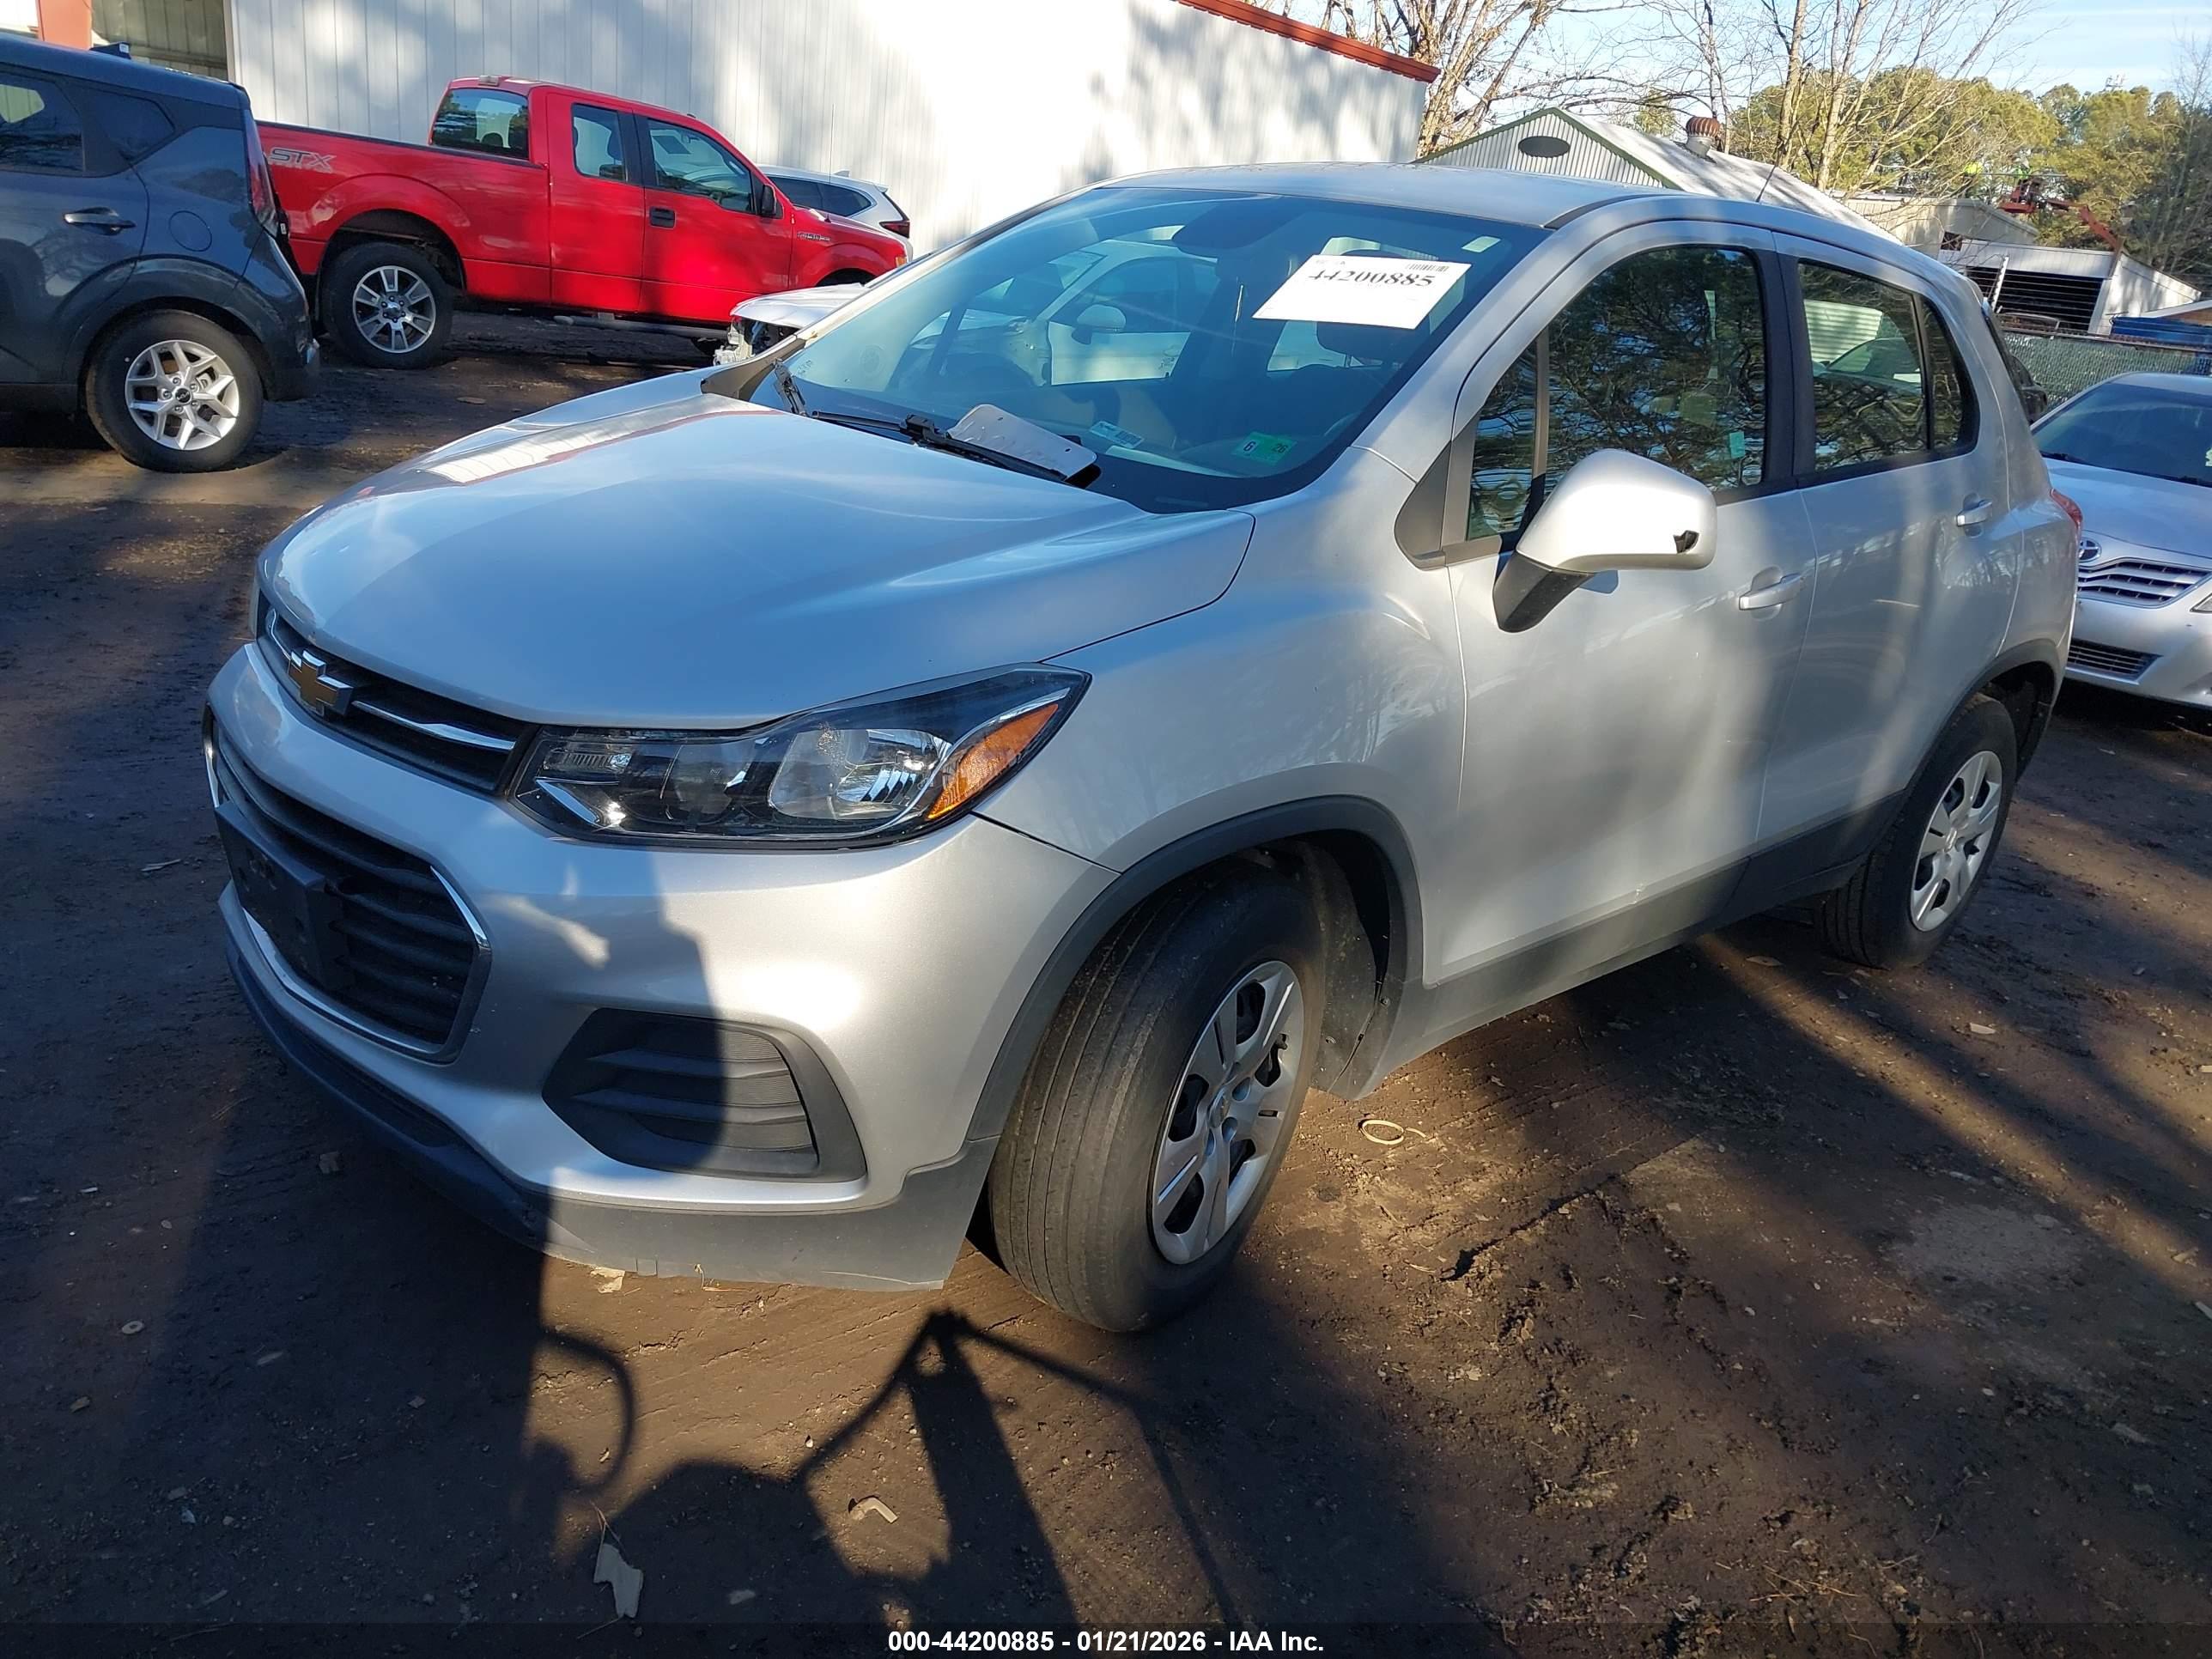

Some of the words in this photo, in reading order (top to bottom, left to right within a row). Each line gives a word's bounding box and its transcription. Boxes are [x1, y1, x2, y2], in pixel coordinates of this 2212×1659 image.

[269, 147, 337, 173] STX
[1308, 270, 1436, 287] 44200885
[1243, 441, 1256, 452] 6
